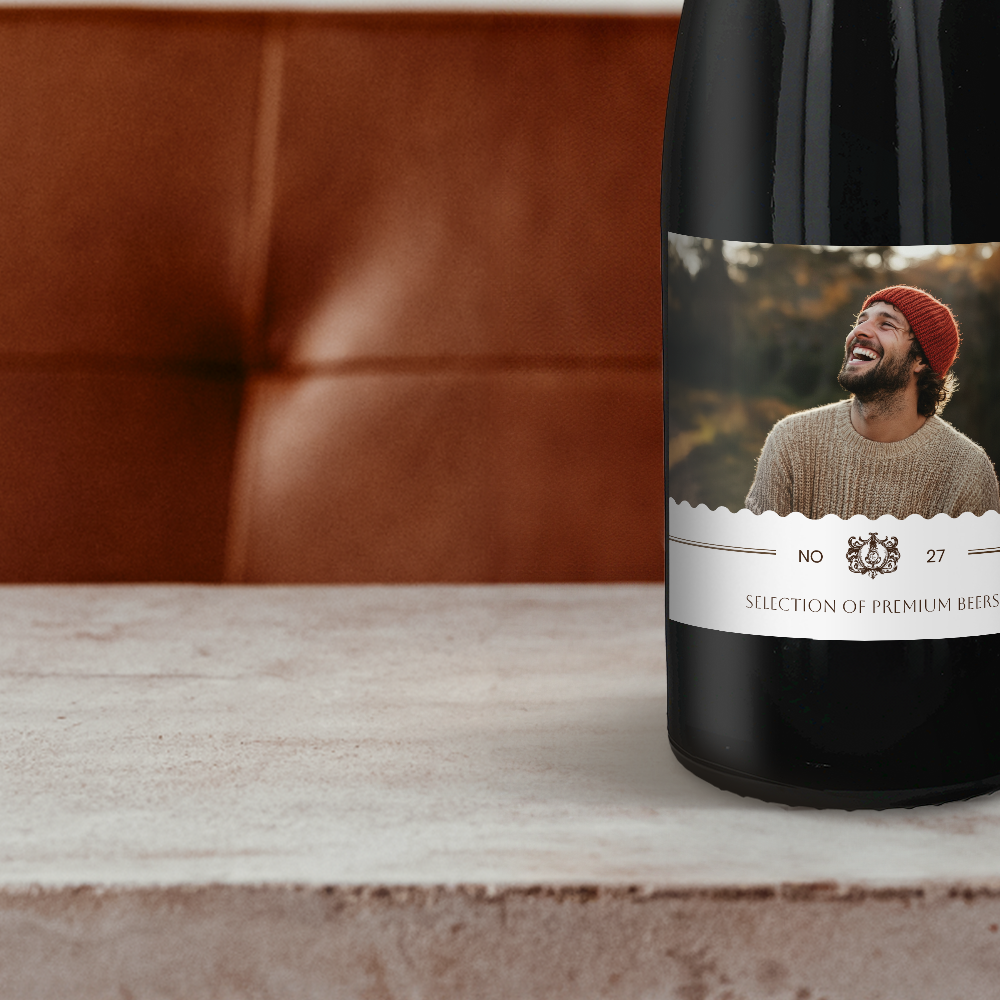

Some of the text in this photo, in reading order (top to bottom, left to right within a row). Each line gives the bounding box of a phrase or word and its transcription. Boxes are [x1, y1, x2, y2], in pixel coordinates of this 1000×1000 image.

[798, 548, 946, 564] NO 27
[745, 593, 1000, 614] SELECTION OF PREMIUM BEERS
